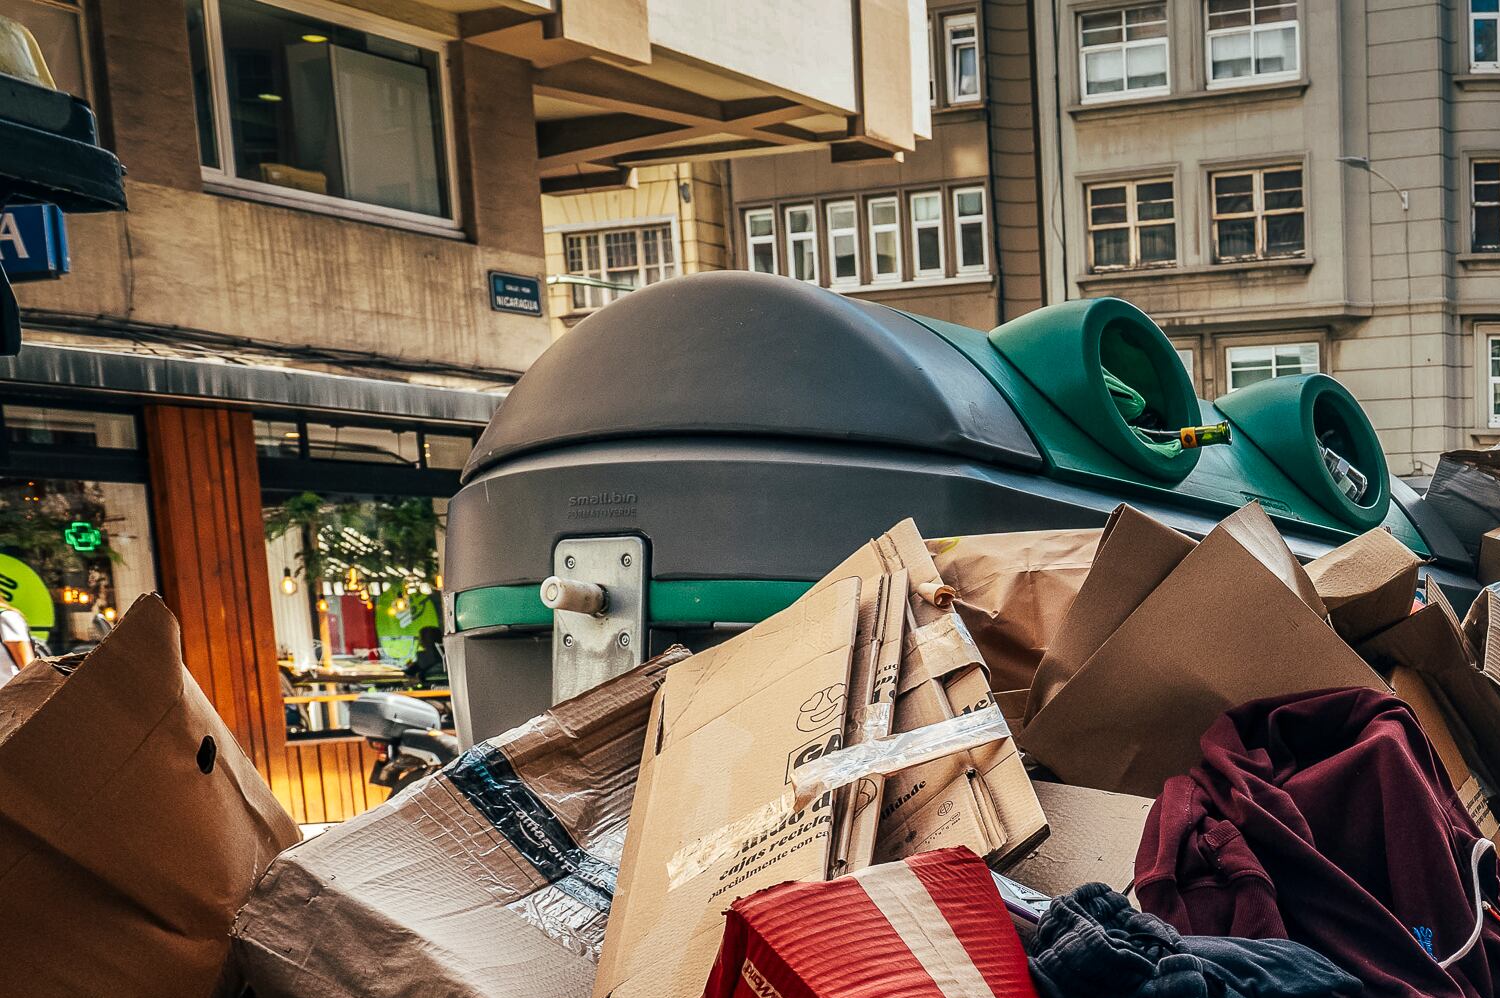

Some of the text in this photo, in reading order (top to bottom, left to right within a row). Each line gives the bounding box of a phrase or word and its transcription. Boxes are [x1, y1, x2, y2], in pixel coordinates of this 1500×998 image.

[496, 296, 539, 310] NICARAGUA
[515, 809, 566, 861] amazon
[790, 836, 814, 853] con
[719, 848, 766, 882] cajas
